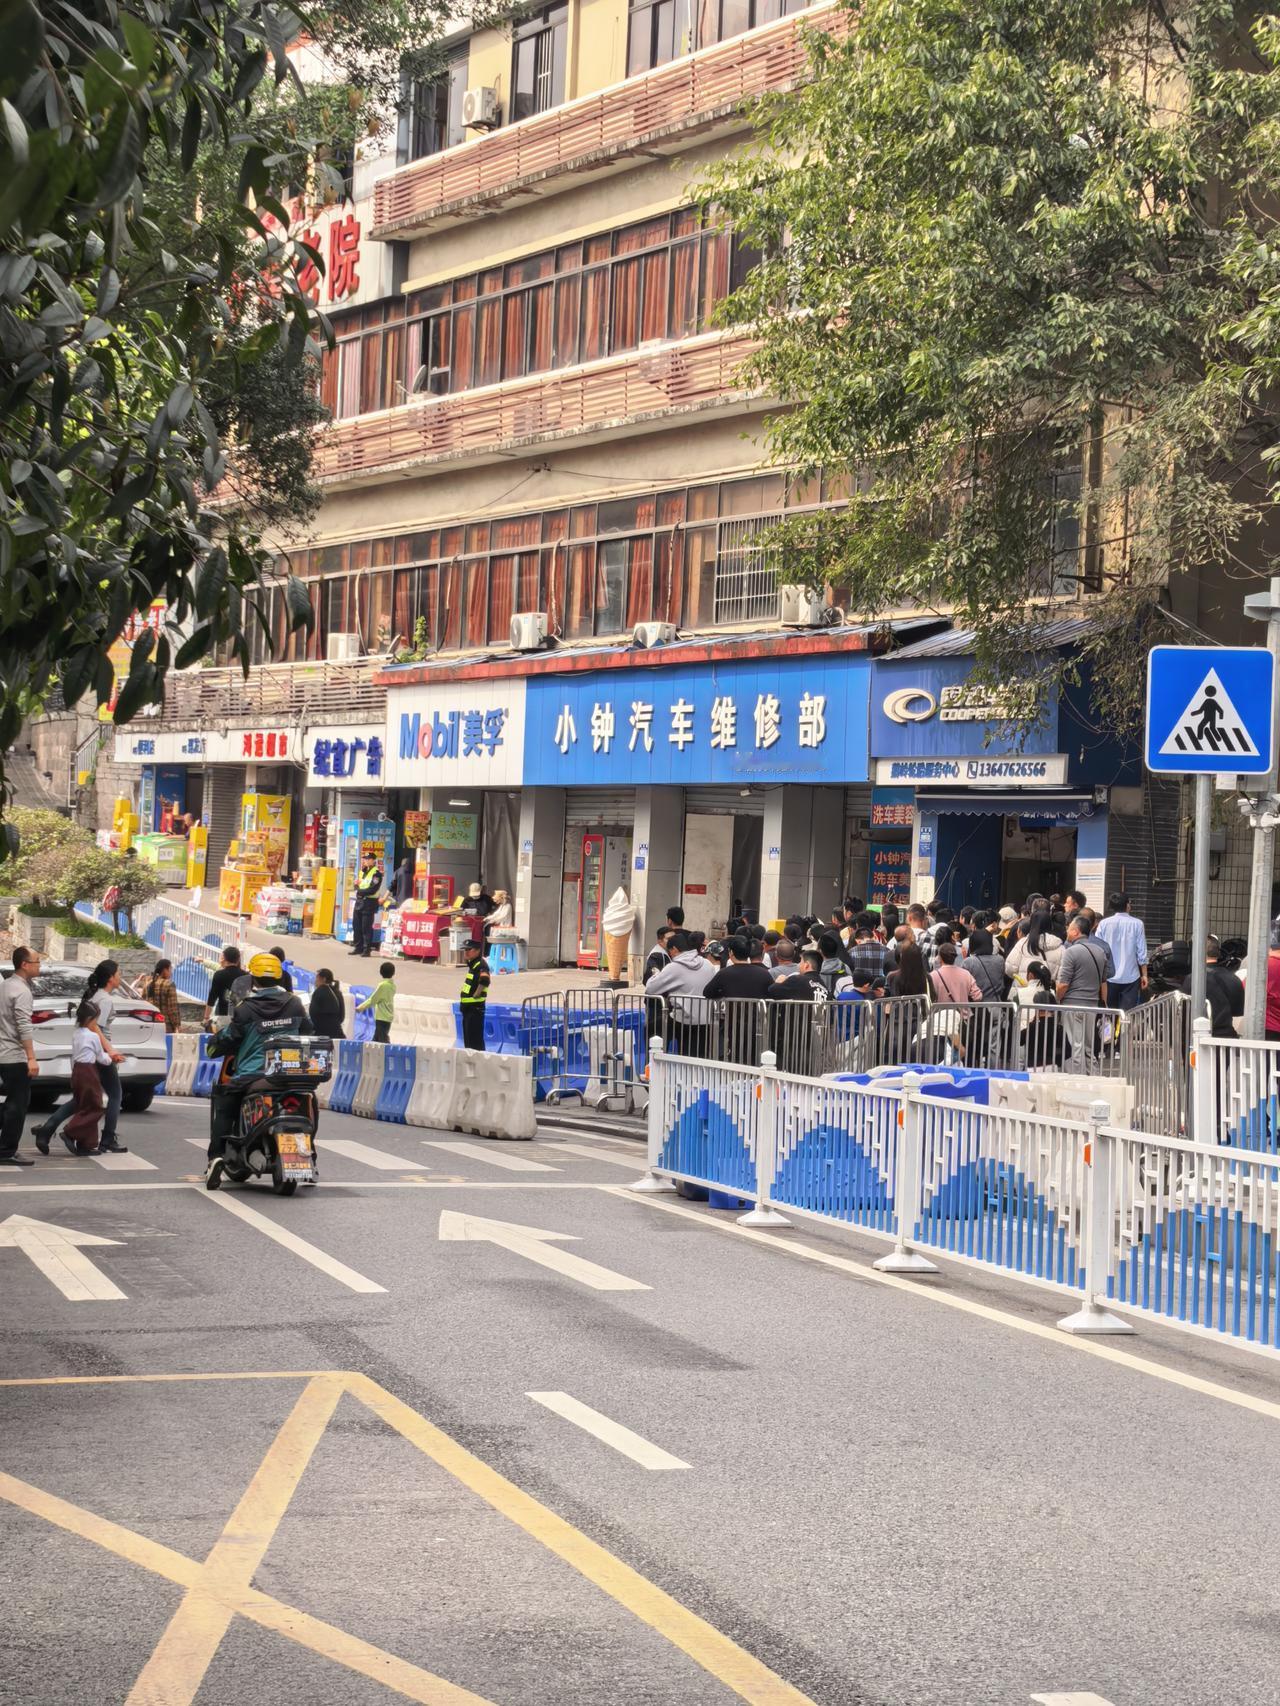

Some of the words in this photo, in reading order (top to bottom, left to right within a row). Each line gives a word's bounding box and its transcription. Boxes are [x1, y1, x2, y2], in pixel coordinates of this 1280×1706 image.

[400, 711, 461, 759] Mobil
[554, 691, 827, 754] 小钟汽车维修部
[978, 762, 1046, 777] 13647626566
[872, 804, 914, 825] 洗车美容
